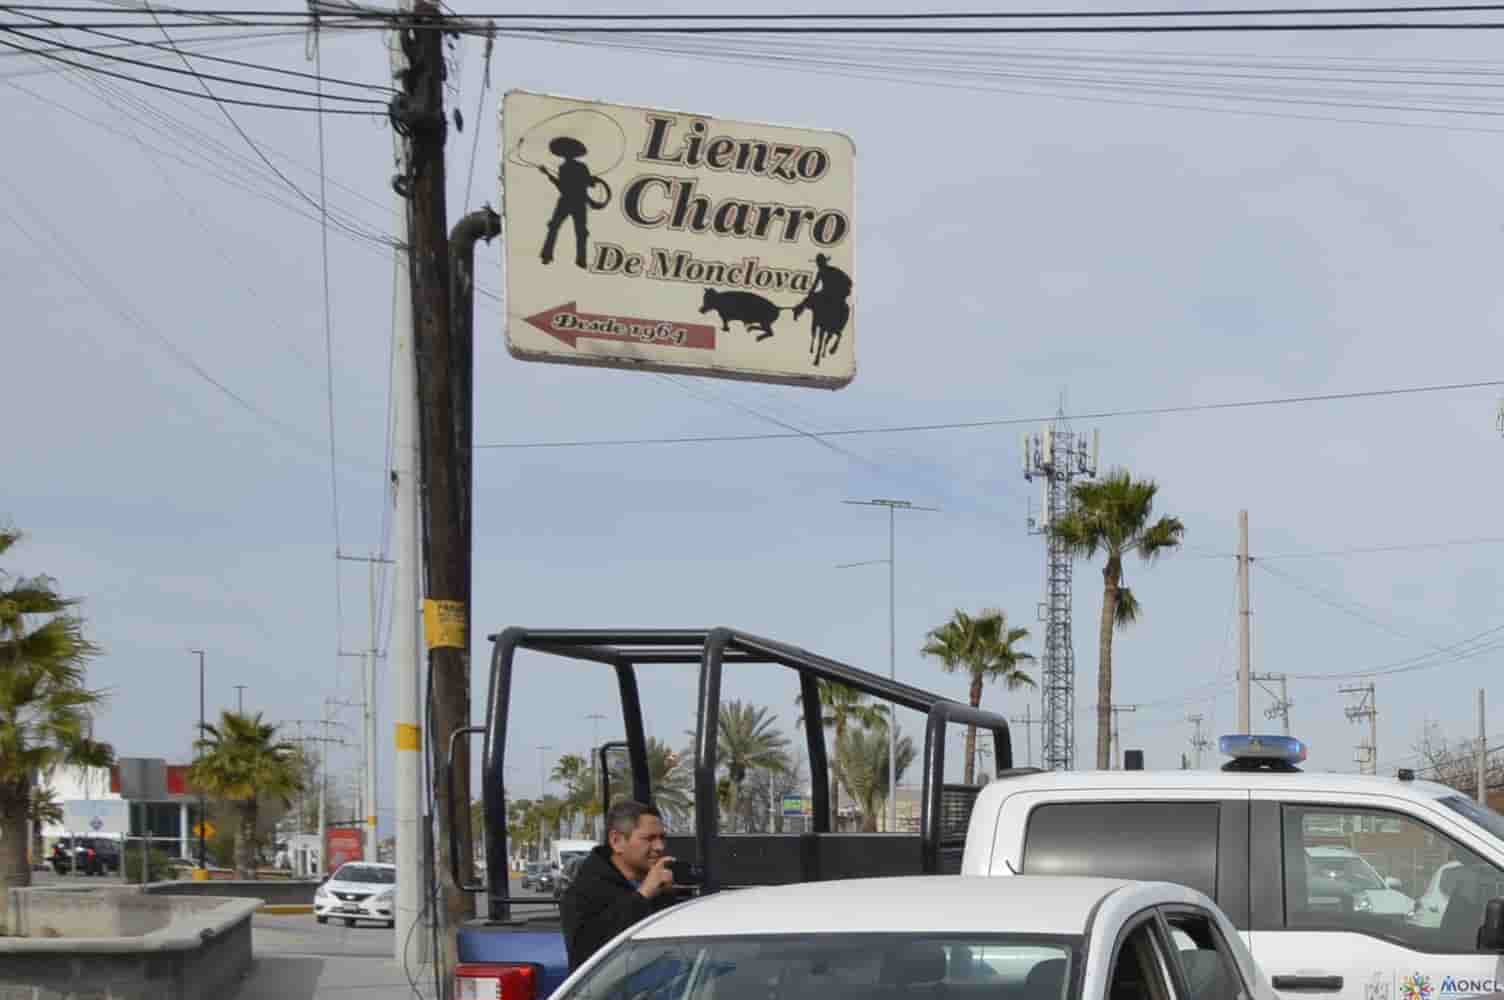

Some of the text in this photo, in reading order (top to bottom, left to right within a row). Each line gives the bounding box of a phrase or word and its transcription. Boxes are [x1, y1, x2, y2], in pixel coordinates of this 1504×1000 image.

[639, 114, 829, 181] Lienzo
[621, 174, 849, 248] Charro
[593, 243, 813, 292] De Monclova
[553, 311, 689, 345] Desde 1964
